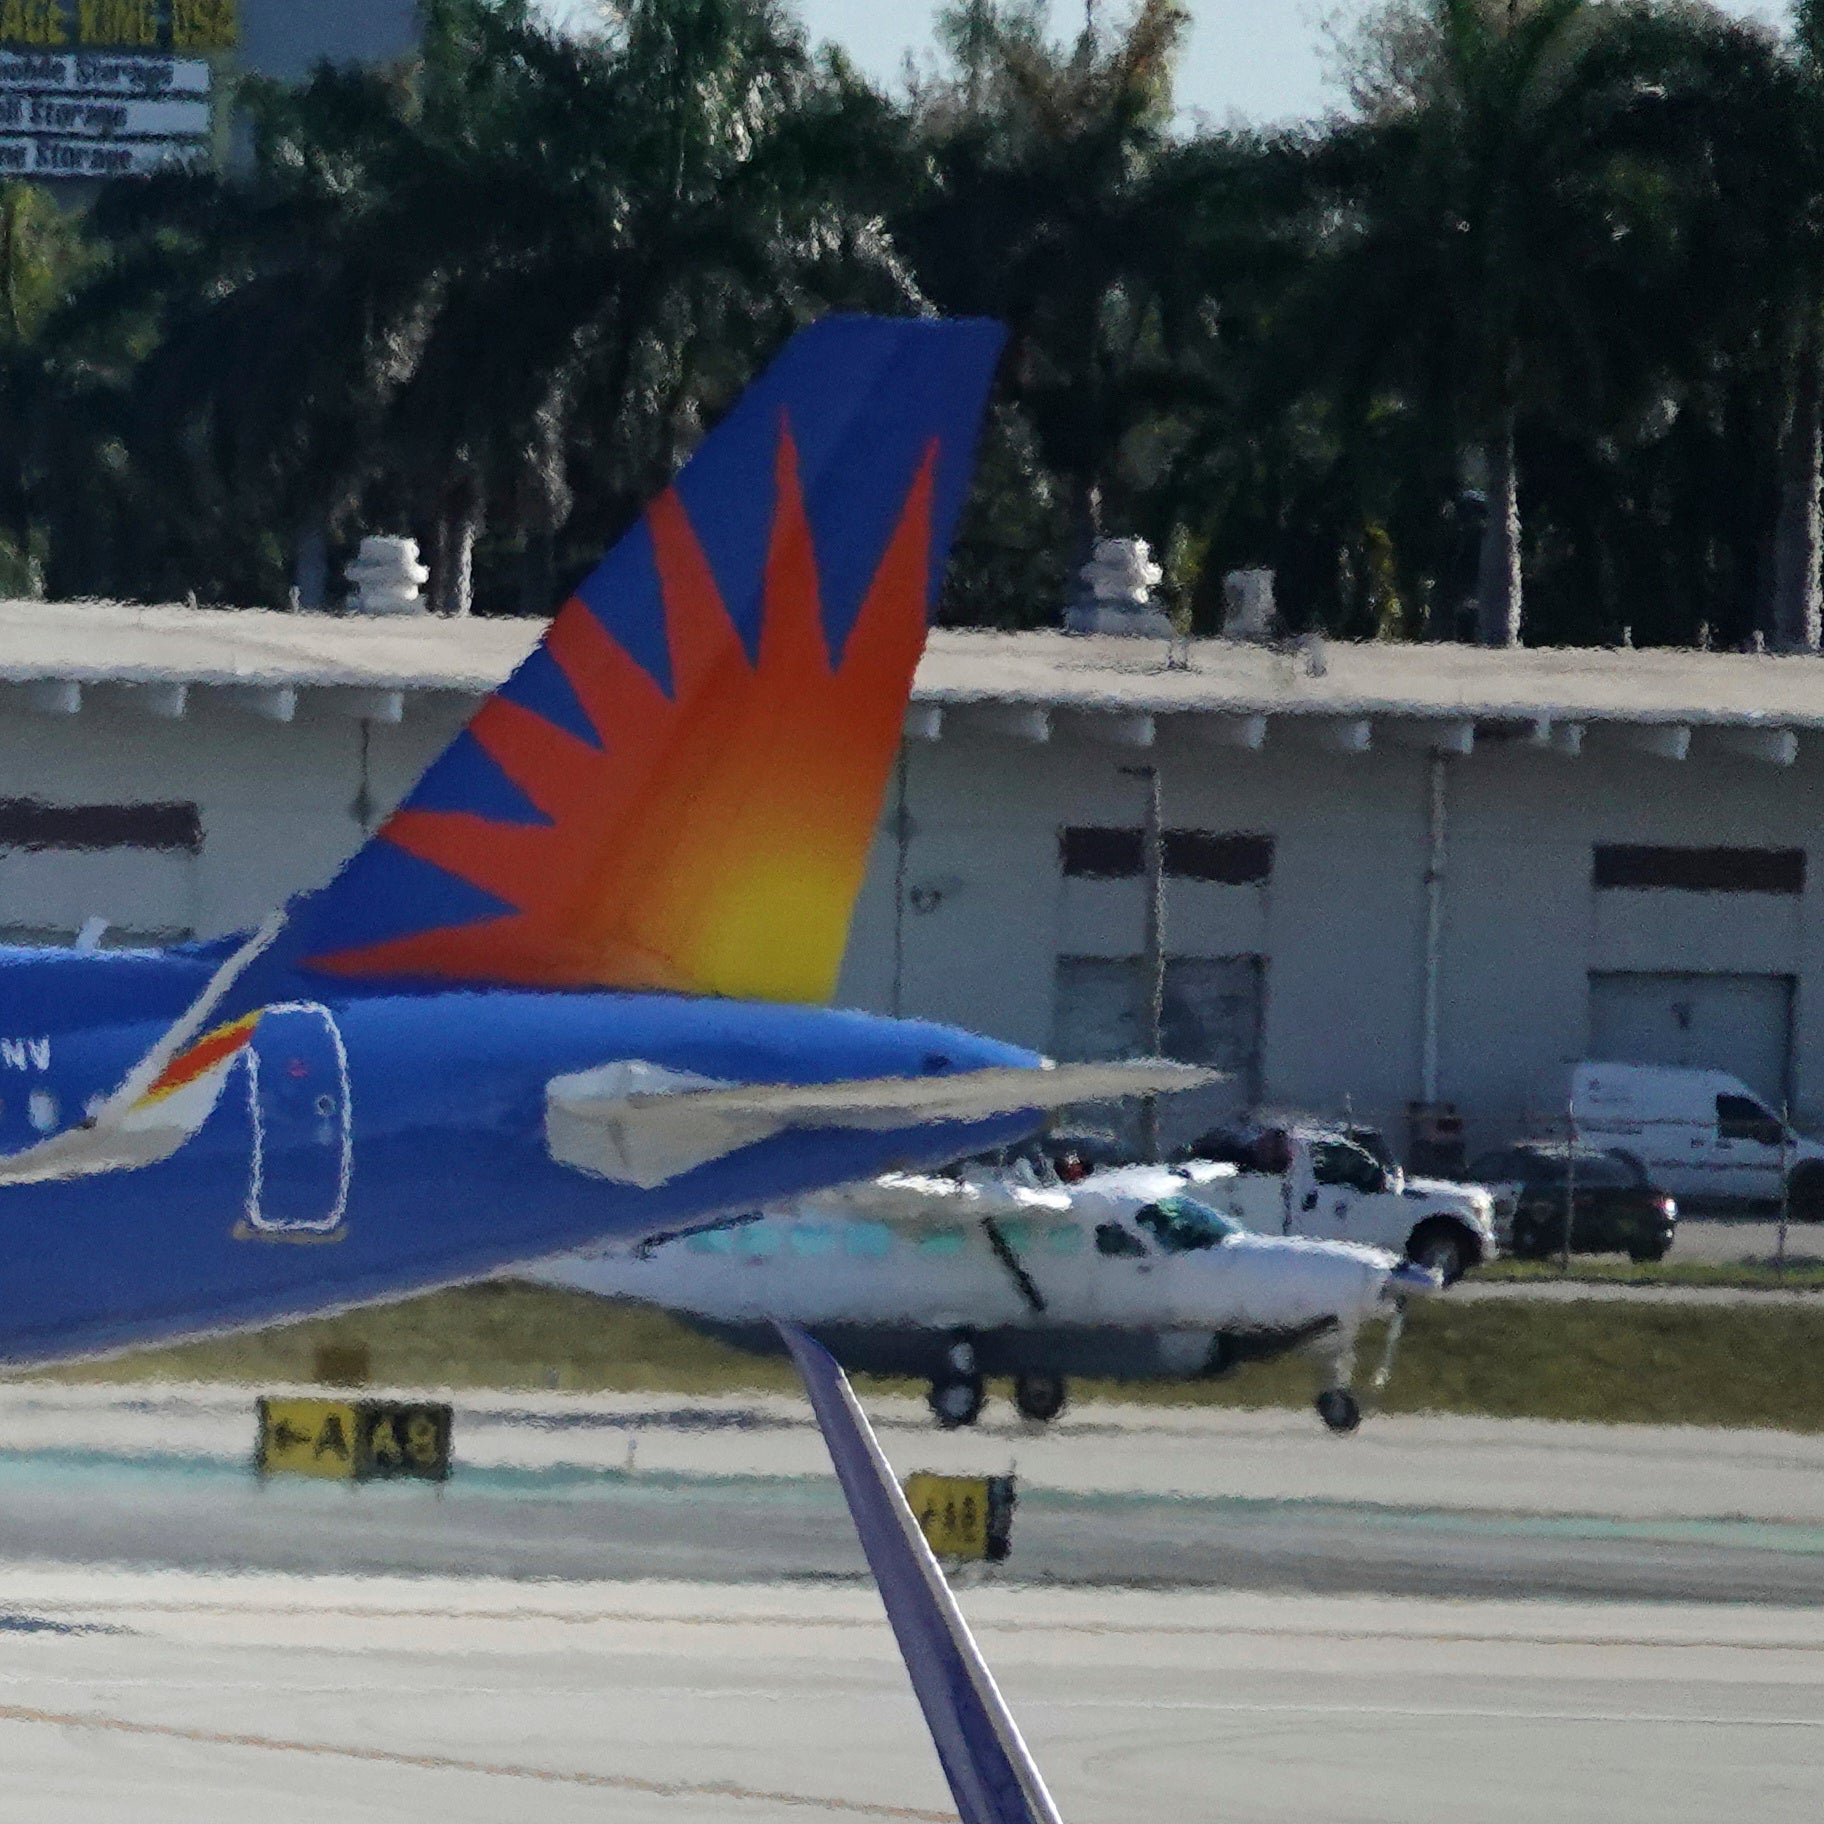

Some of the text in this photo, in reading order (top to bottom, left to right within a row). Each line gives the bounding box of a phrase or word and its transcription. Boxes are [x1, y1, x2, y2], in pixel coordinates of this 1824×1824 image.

[75, 56, 174, 92] Storage
[30, 99, 127, 132] Storage
[35, 138, 133, 172] Storage
